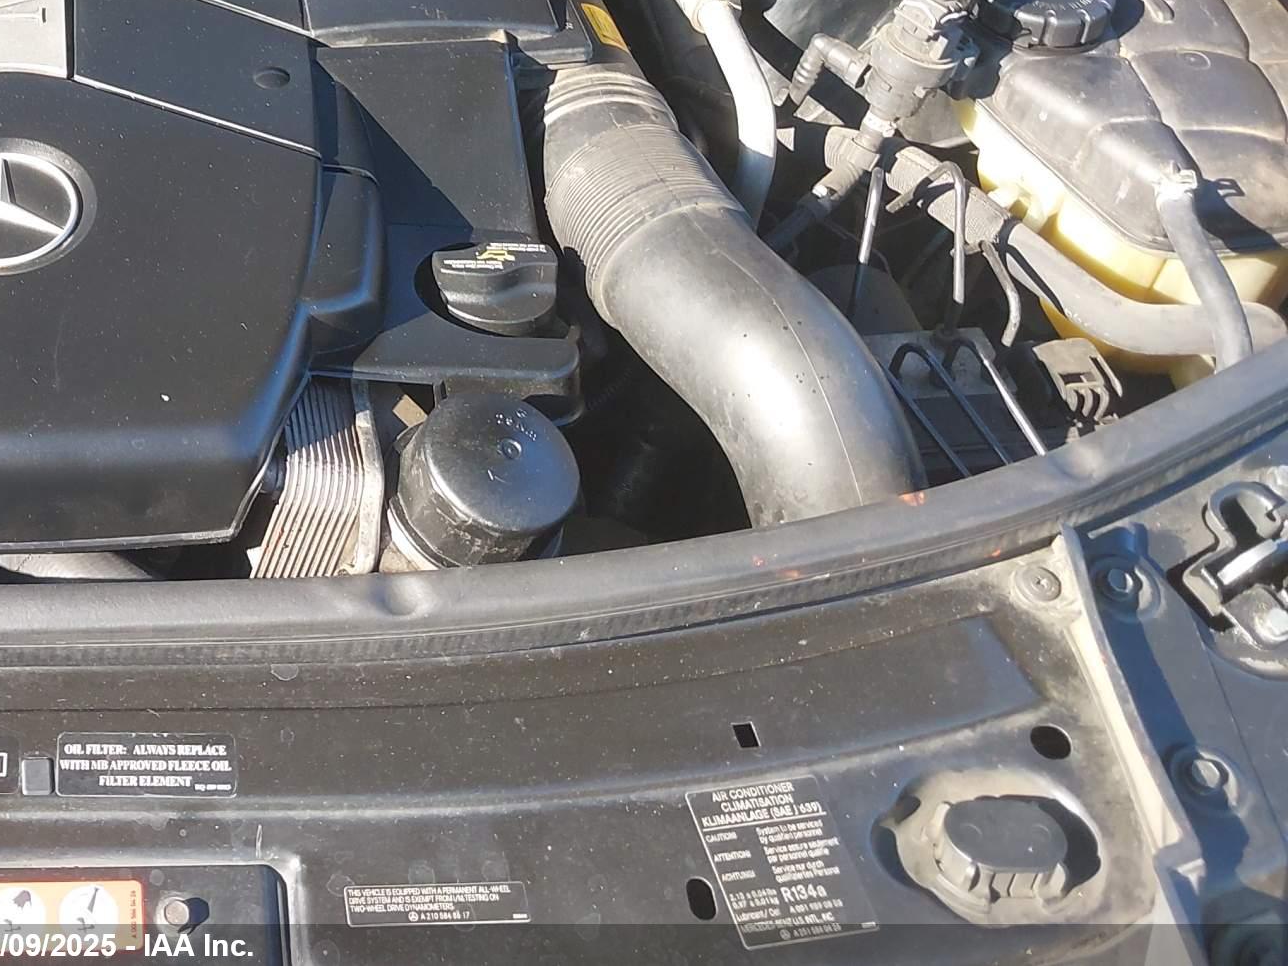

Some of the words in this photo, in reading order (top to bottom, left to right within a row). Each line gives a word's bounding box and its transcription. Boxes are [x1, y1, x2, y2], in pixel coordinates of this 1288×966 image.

[64, 744, 84, 754] OIL
[86, 744, 127, 754] FILTER:
[133, 744, 176, 755] ALWAYS
[178, 744, 226, 755] REPLACE
[60, 760, 90, 771] WITH
[92, 760, 108, 770] MB
[111, 760, 166, 771] APPROVED
[168, 760, 210, 771] FLEECE
[212, 760, 232, 771] OIL
[99, 776, 138, 786] FILTER
[139, 776, 192, 787] ELEMENT
[712, 791, 728, 802] AIR
[729, 782, 794, 799] CONDITIONER
[721, 794, 793, 812] CLIMATISATION
[702, 809, 769, 826] KLIMAANLAGE
[770, 805, 792, 818] (SAE
[799, 802, 822, 813] 639)
[392, 887, 420, 896] EQUIPPED
[442, 886, 476, 894] PERMANENT
[478, 885, 511, 893] ALL-WHEEL
[781, 884, 826, 902] R134a
[412, 895, 434, 903] EXEMPT
[464, 893, 488, 901] TESTING
